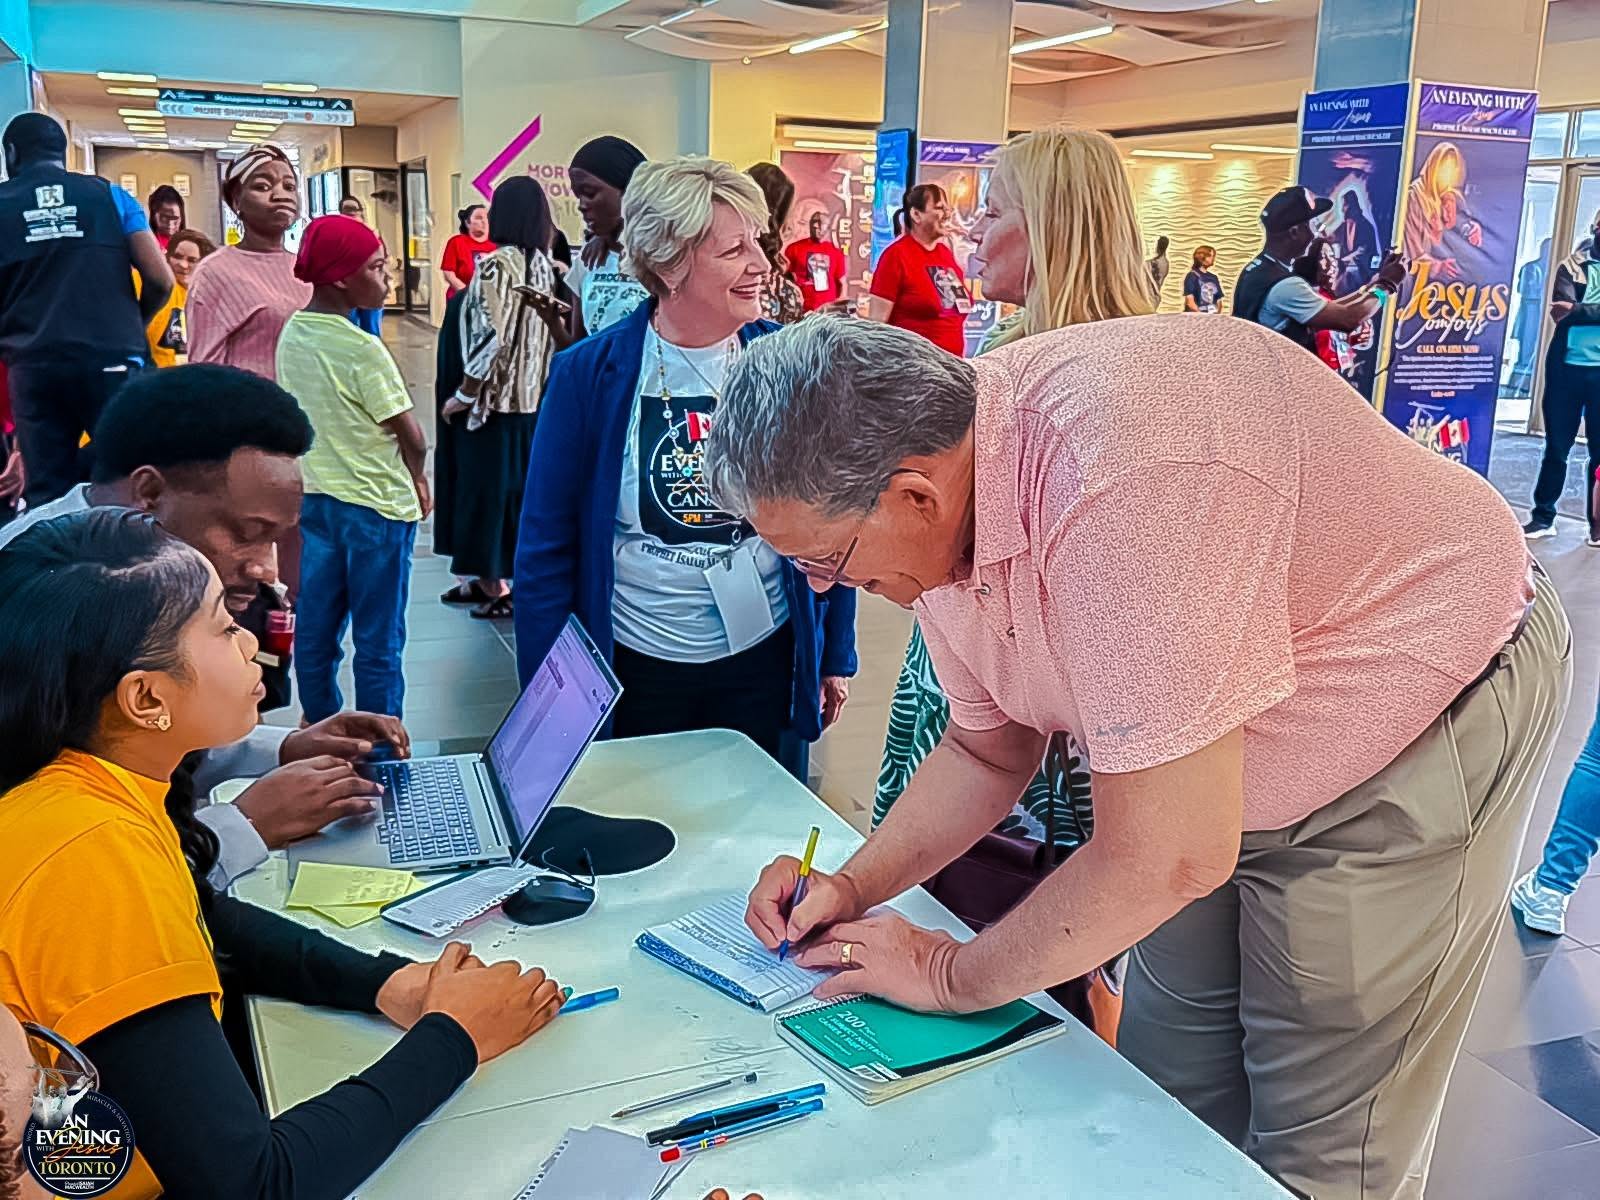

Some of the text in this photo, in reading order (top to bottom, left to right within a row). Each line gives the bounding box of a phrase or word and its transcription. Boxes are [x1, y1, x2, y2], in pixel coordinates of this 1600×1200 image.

[1448, 90, 1493, 107] EVENING
[1494, 94, 1527, 110] WITH
[528, 163, 564, 179] MOR
[667, 491, 712, 508] CAN
[682, 513, 702, 523] 5PM
[837, 1010, 866, 1028] 200
